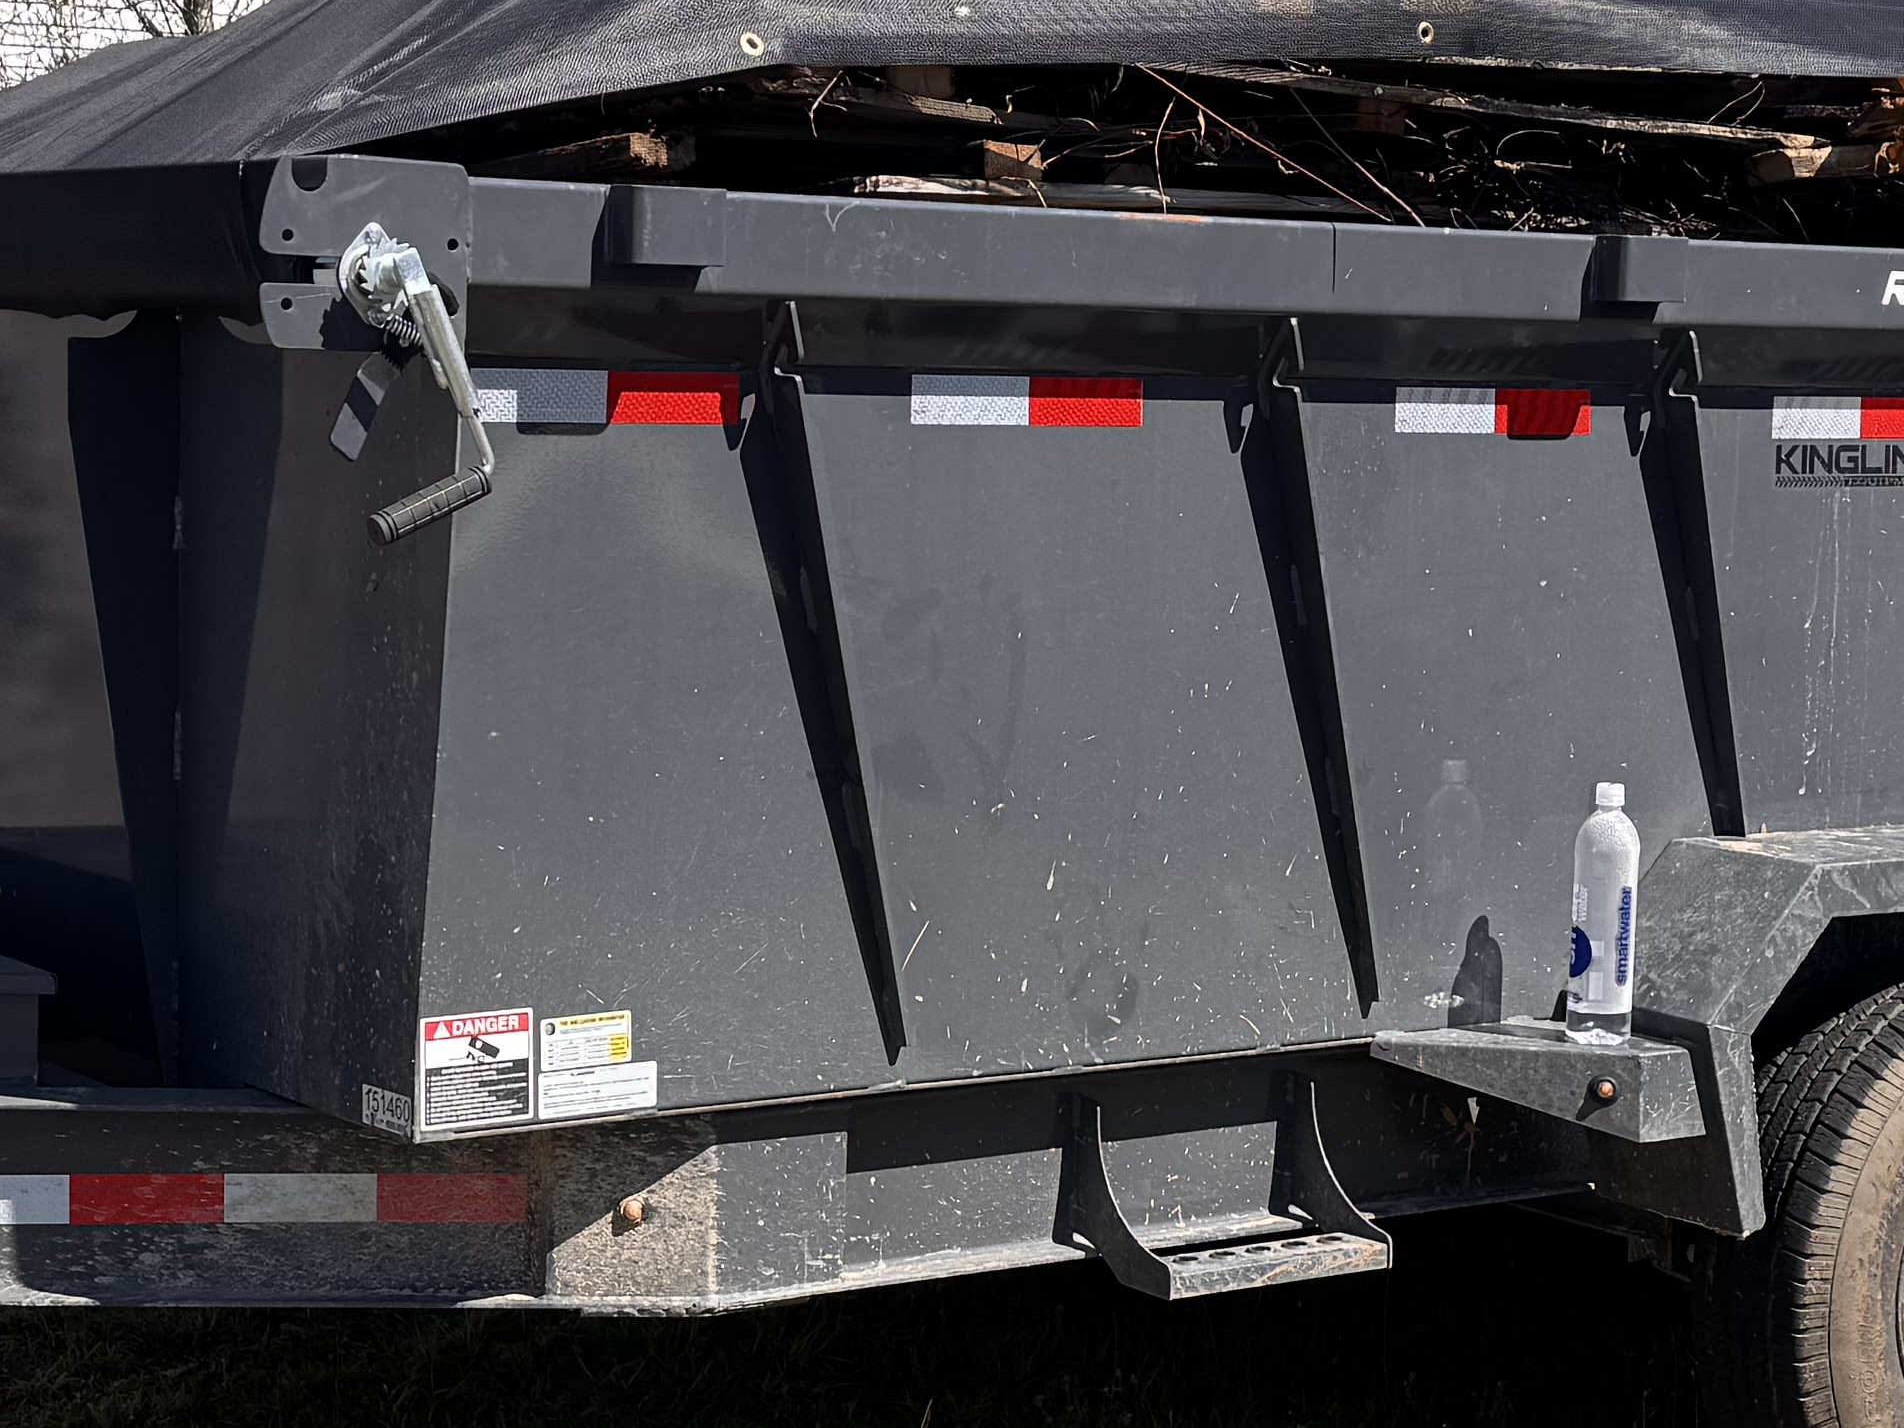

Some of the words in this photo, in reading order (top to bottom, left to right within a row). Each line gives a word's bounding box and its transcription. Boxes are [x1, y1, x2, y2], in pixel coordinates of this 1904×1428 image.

[1616, 886, 1633, 986] smartwater
[452, 1015, 520, 1036] DANGER
[365, 1088, 411, 1122] 151460
